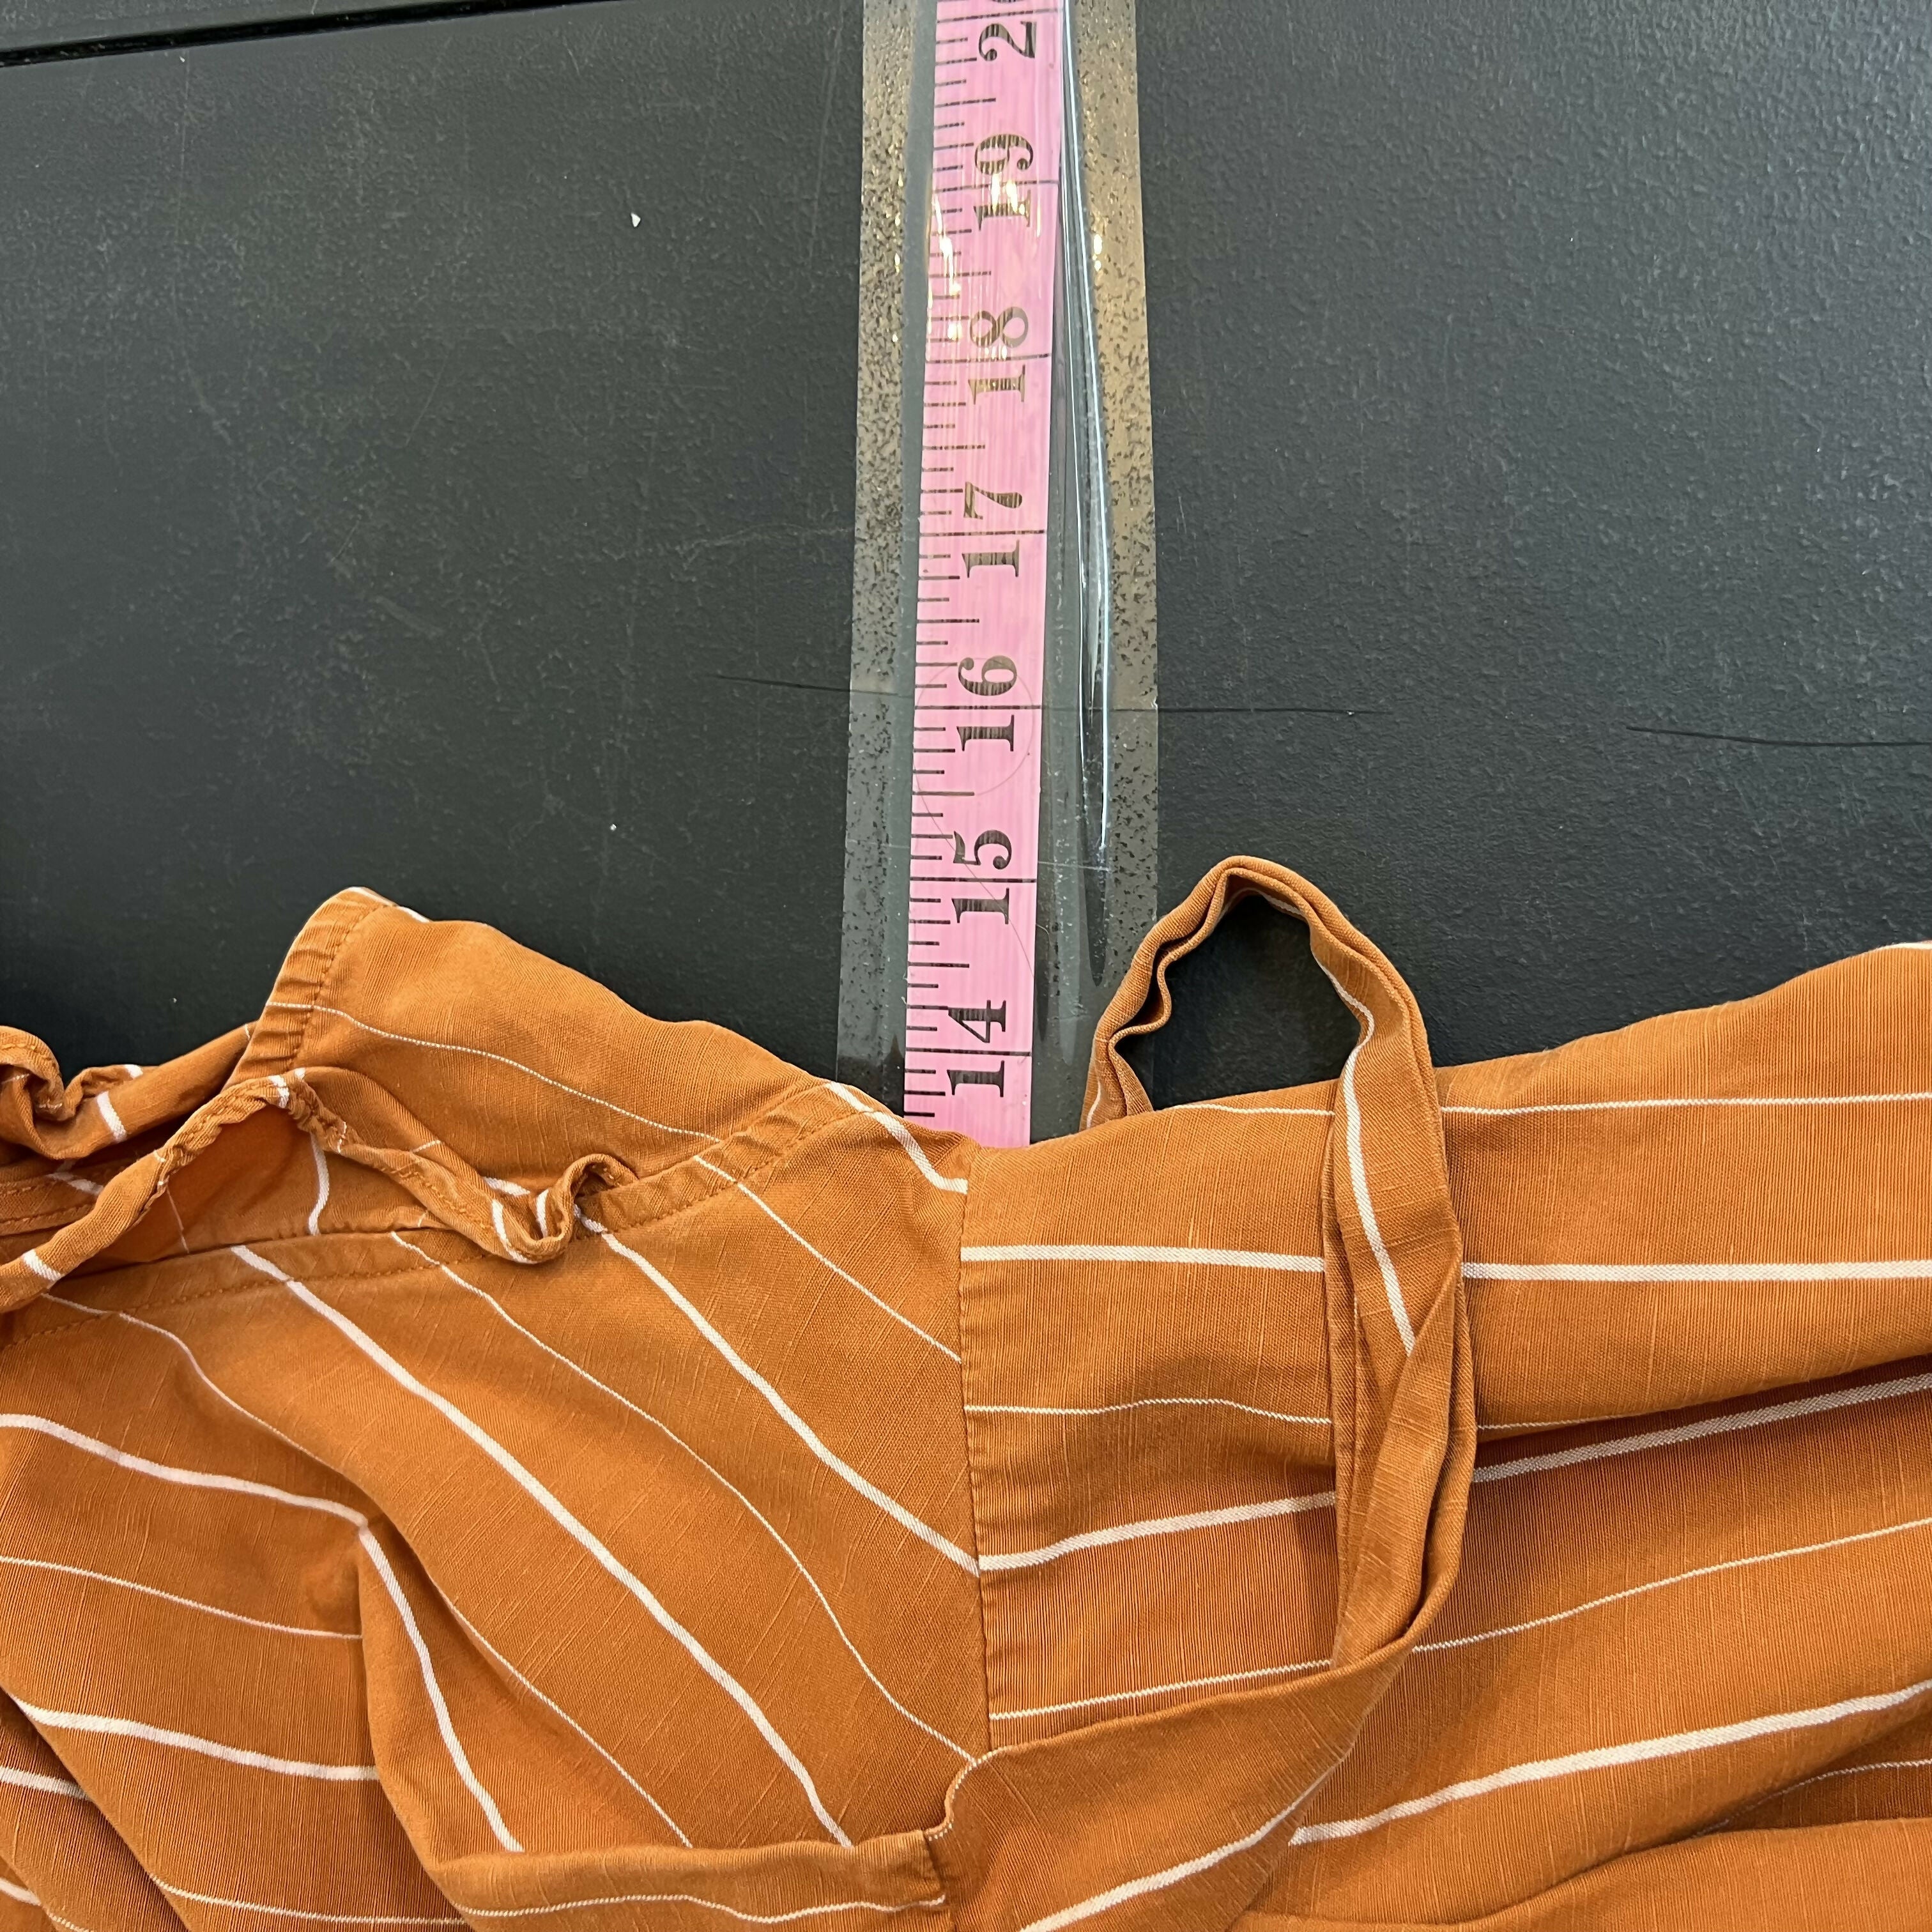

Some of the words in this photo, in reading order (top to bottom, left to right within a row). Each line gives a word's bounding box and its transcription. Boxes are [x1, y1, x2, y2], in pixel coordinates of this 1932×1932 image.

[978, 0, 1037, 61] 2
[973, 132, 1034, 231] 19
[967, 306, 1029, 404] 18
[961, 481, 1023, 578] 17
[956, 655, 1018, 752] 16
[951, 829, 1013, 924] 15
[947, 1000, 1007, 1098] 14
